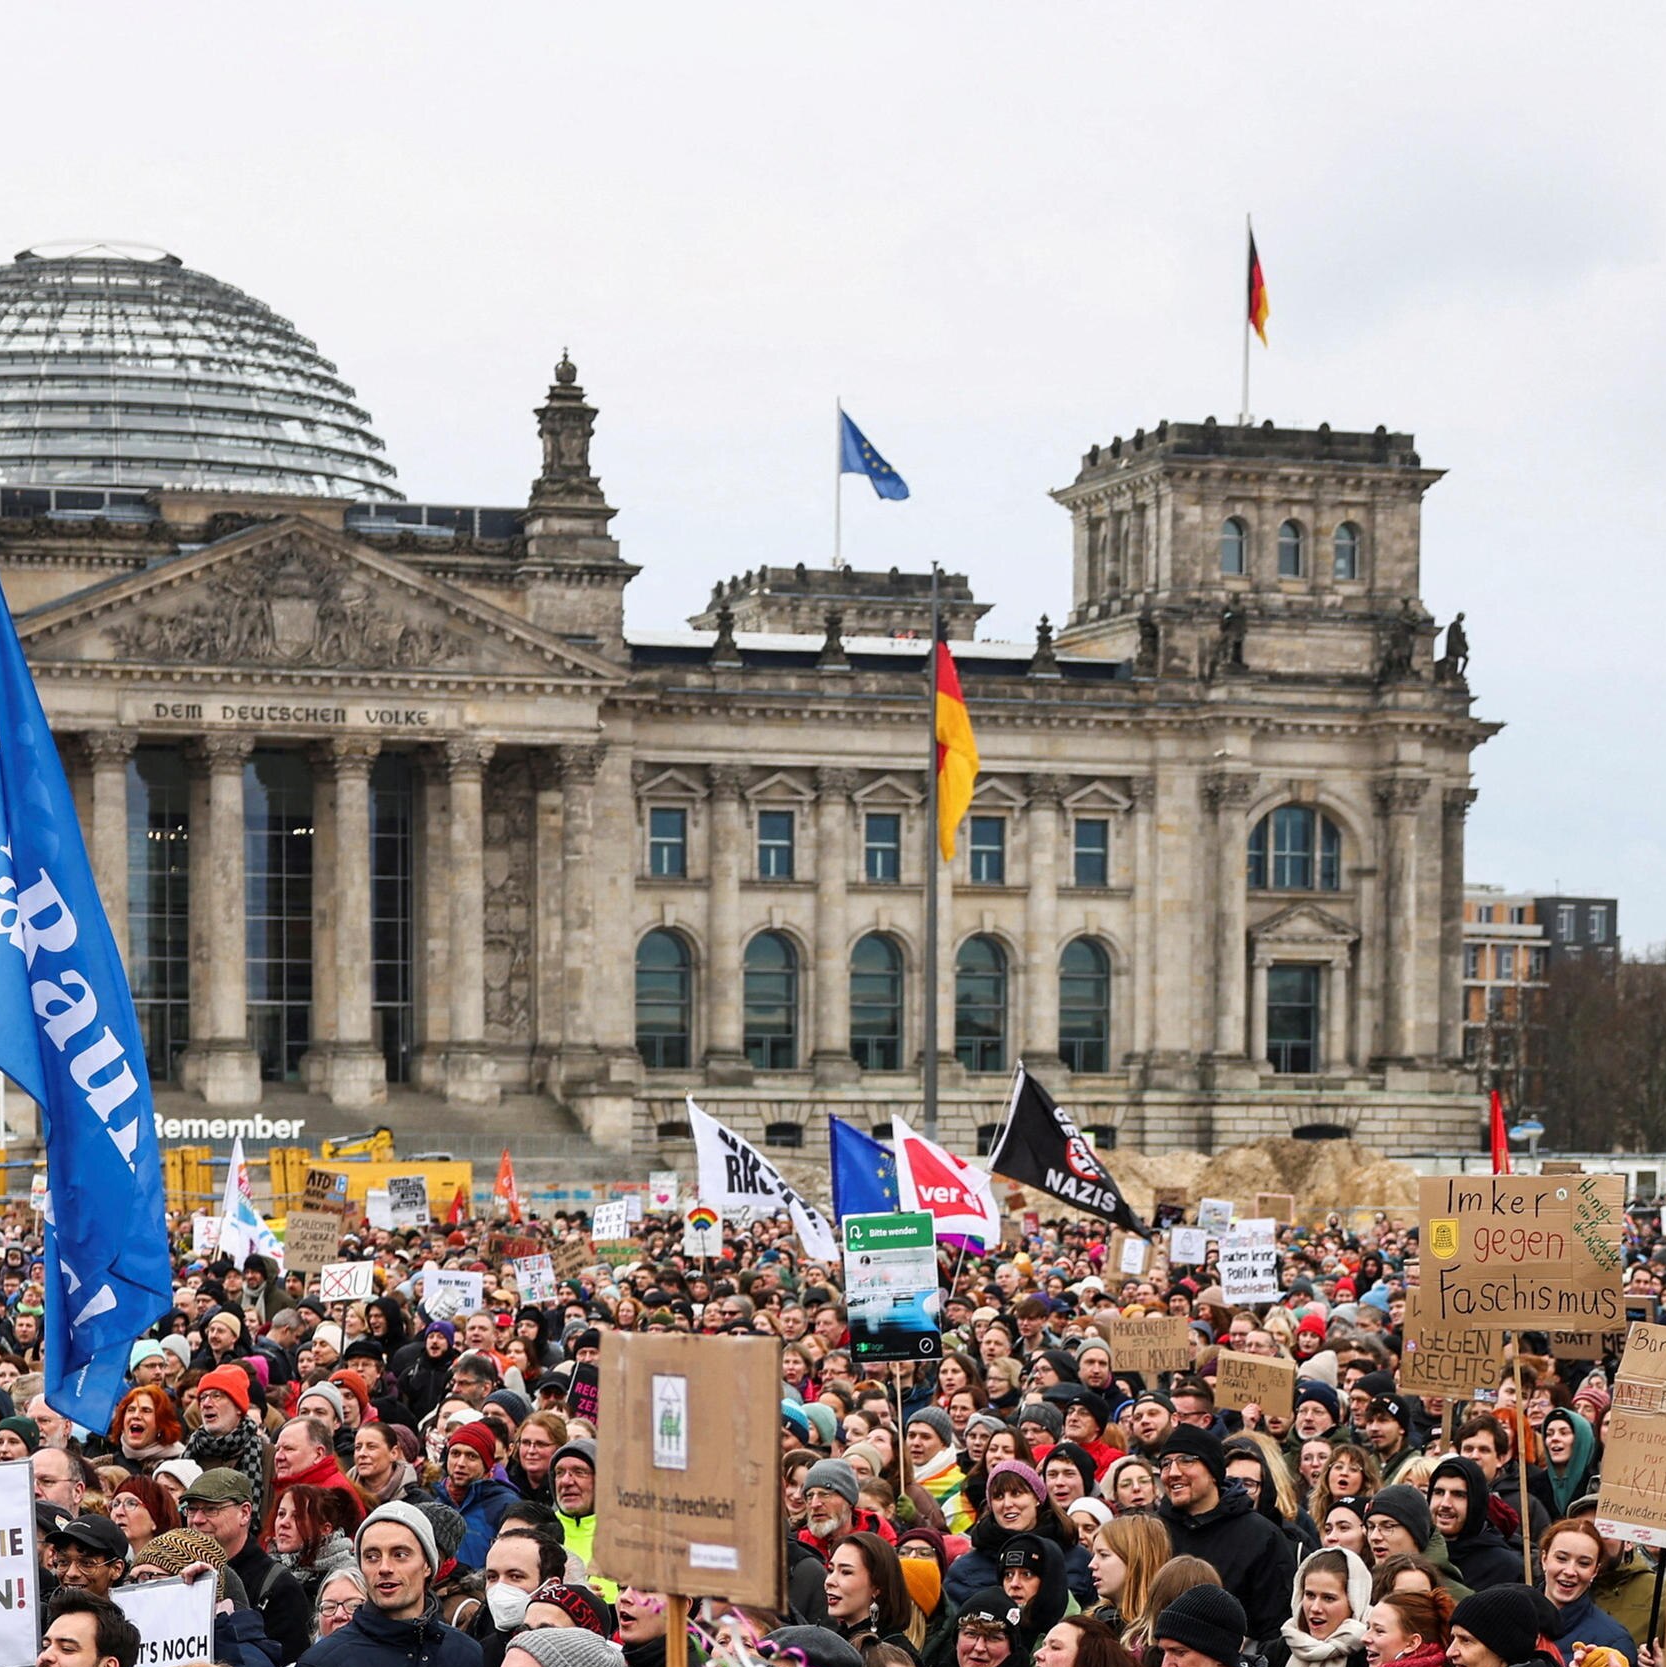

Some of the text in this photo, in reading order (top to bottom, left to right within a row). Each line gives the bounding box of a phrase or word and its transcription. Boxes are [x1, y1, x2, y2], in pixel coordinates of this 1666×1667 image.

[154, 703, 429, 726] DEM DEUTSCHEN VOLKE
[1045, 1169, 1117, 1212] NAZIS
[1446, 1180, 1550, 1219] Imker
[869, 1226, 918, 1237] Bitte wenden
[1473, 1226, 1566, 1263] gegen
[1438, 1264, 1619, 1320] Faschismus
[1420, 1328, 1491, 1356] GEGEN
[1411, 1351, 1496, 1386] RECHTS
[616, 1486, 736, 1522] Vorsicht zerbrechlich!
[163, 1635, 208, 1662] NOCH
